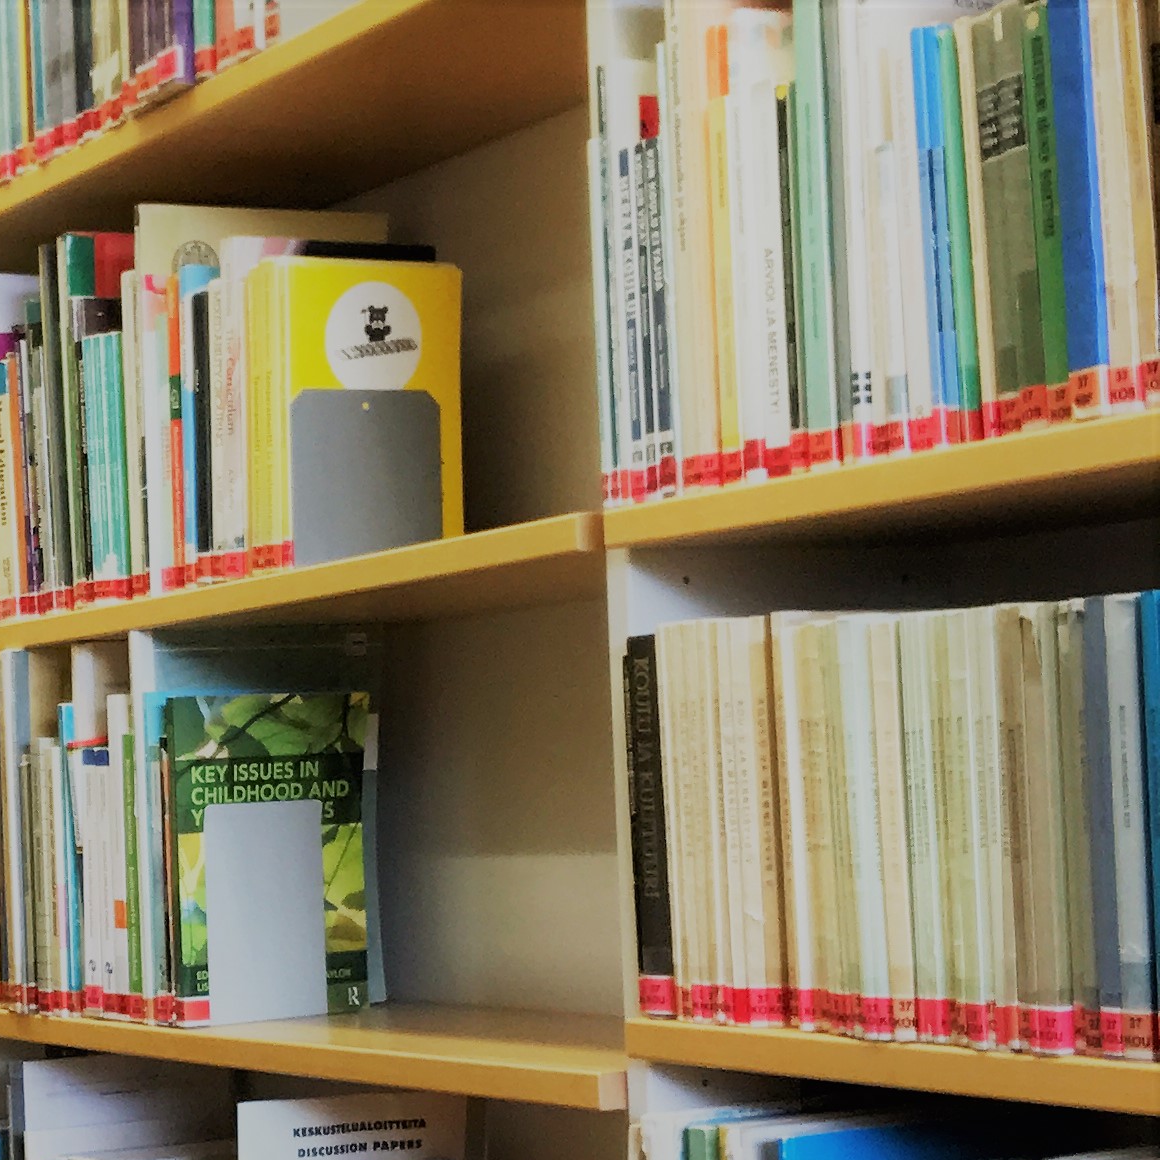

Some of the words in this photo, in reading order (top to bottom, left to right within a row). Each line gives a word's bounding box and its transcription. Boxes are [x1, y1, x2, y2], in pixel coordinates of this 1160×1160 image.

[191, 765, 228, 784] KEY
[233, 762, 294, 781] ISSUES
[299, 760, 319, 778] IN
[191, 782, 303, 805] CHILDHOOD
[308, 780, 350, 799] AND
[297, 1142, 368, 1158] DISCUSSION
[372, 1138, 423, 1151] PAPERS
